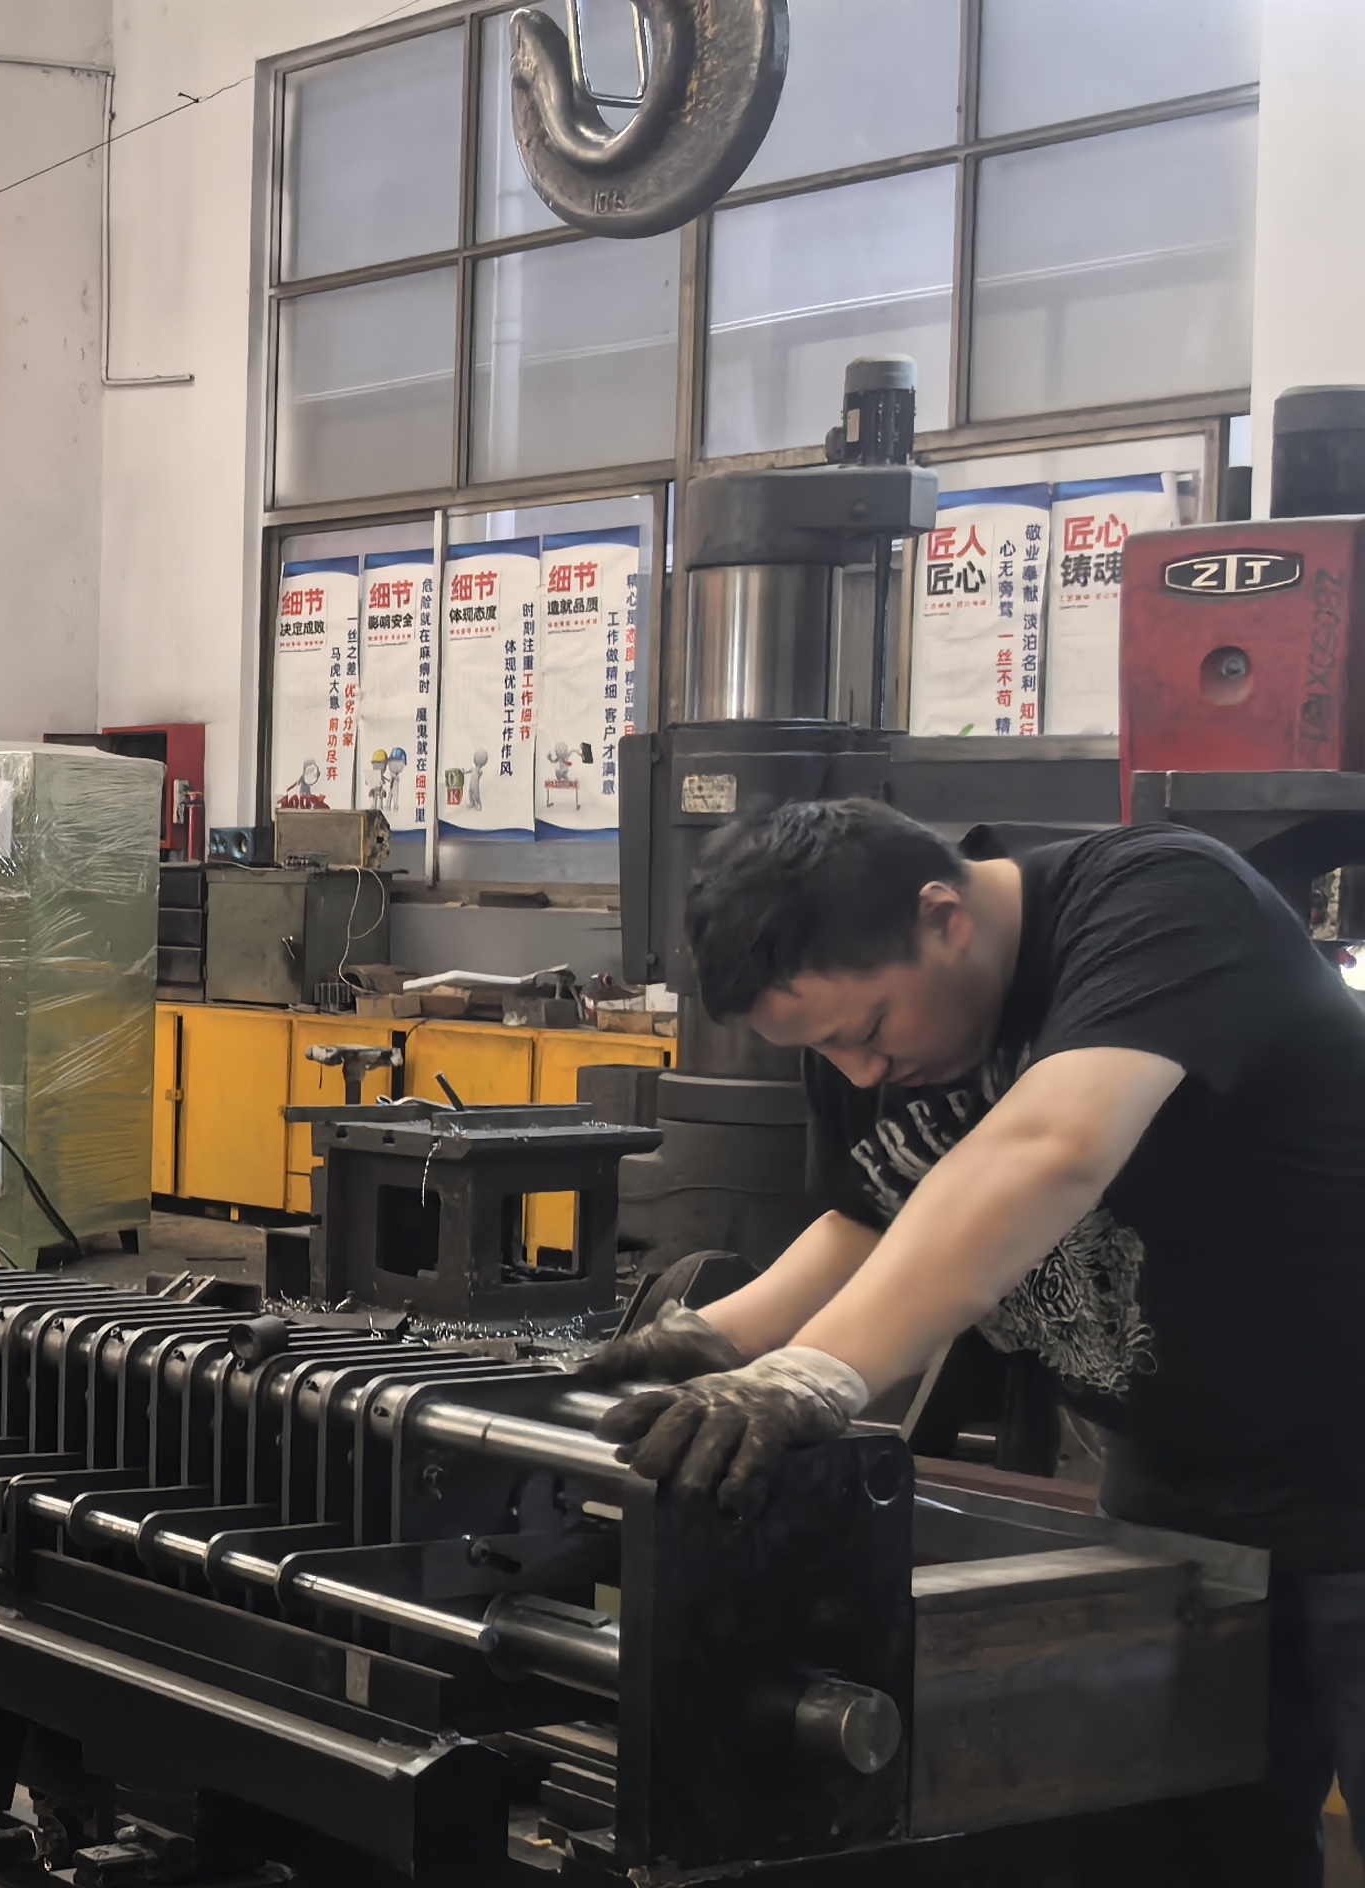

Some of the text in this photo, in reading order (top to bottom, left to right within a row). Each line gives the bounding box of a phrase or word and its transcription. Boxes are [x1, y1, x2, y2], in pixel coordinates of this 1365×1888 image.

[927, 524, 987, 561] 匠人
[1064, 513, 1128, 552] 匠心
[548, 561, 598, 593] 细节
[926, 560, 986, 597] 匠心
[998, 540, 1016, 618] 心无旁骛
[1022, 524, 1044, 602] 敬业奉献
[1060, 551, 1124, 589] 铸魂
[281, 588, 324, 616] 细节
[369, 580, 414, 609] 细节
[450, 571, 497, 601] 细节
[368, 613, 414, 630] 影响安全
[449, 605, 497, 623] 体现态度
[548, 596, 598, 616] 造就品质
[280, 620, 325, 637] 决定成败
[519, 602, 535, 741] 时刻注重工作细节
[995, 634, 1014, 707] 一丝不苟
[1021, 613, 1039, 693] 淡泊名利
[342, 617, 358, 747] 一丝之差 优劣分家
[326, 647, 341, 780] 马虎大意 前功尽弃
[500, 639, 516, 777] 体现优良工作作风
[602, 611, 619, 795] 工作做精细 客户才满意
